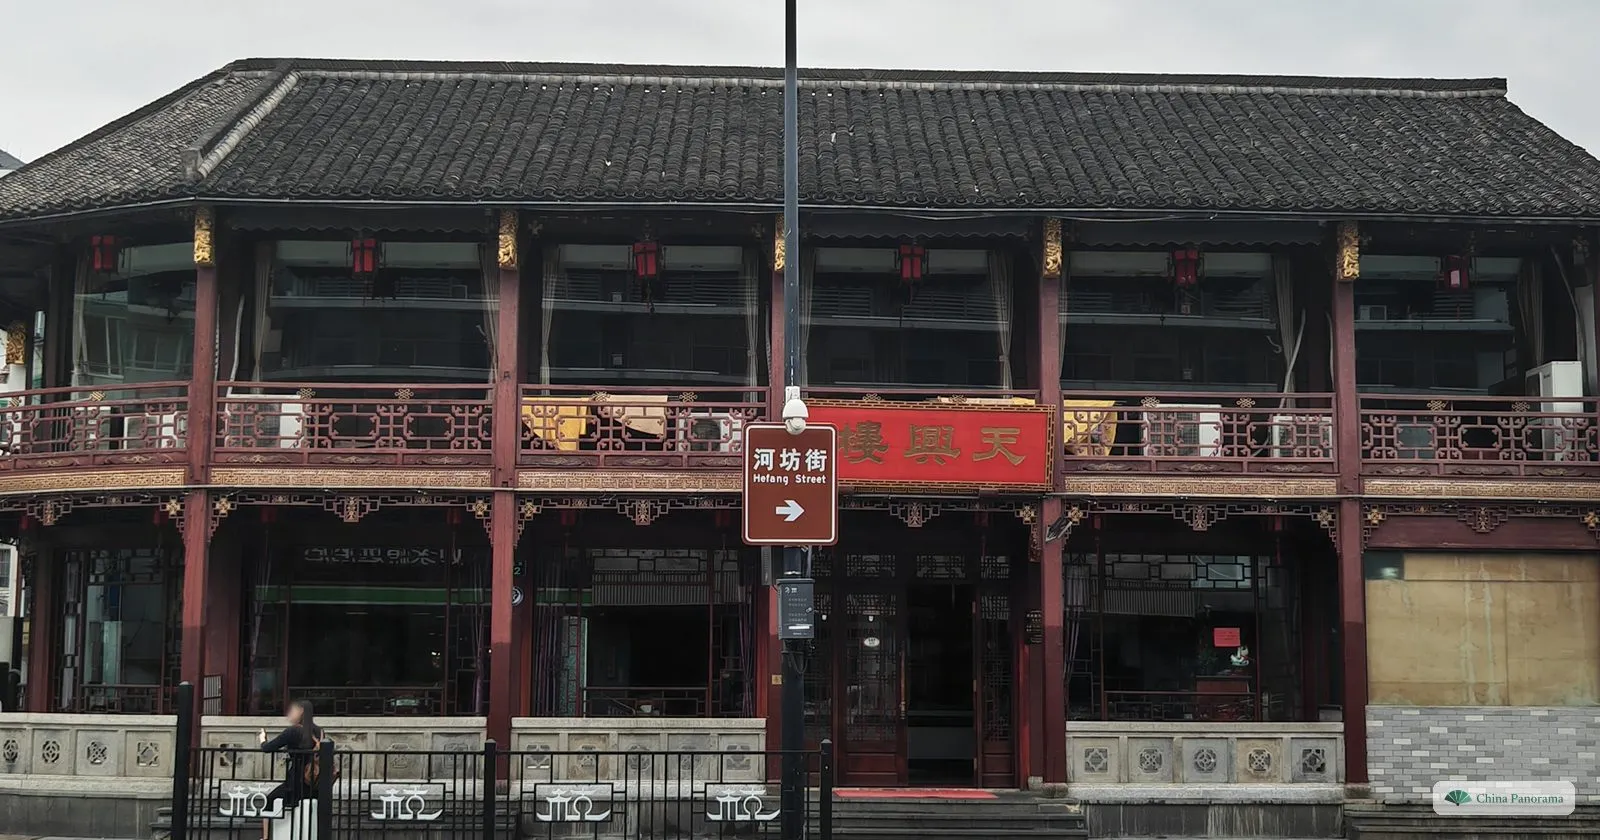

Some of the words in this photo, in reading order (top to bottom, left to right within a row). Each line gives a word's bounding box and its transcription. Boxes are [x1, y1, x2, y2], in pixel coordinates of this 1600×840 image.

[753, 447, 827, 472] 河坊街
[753, 474, 789, 486] Hefang
[795, 474, 827, 484] Street
